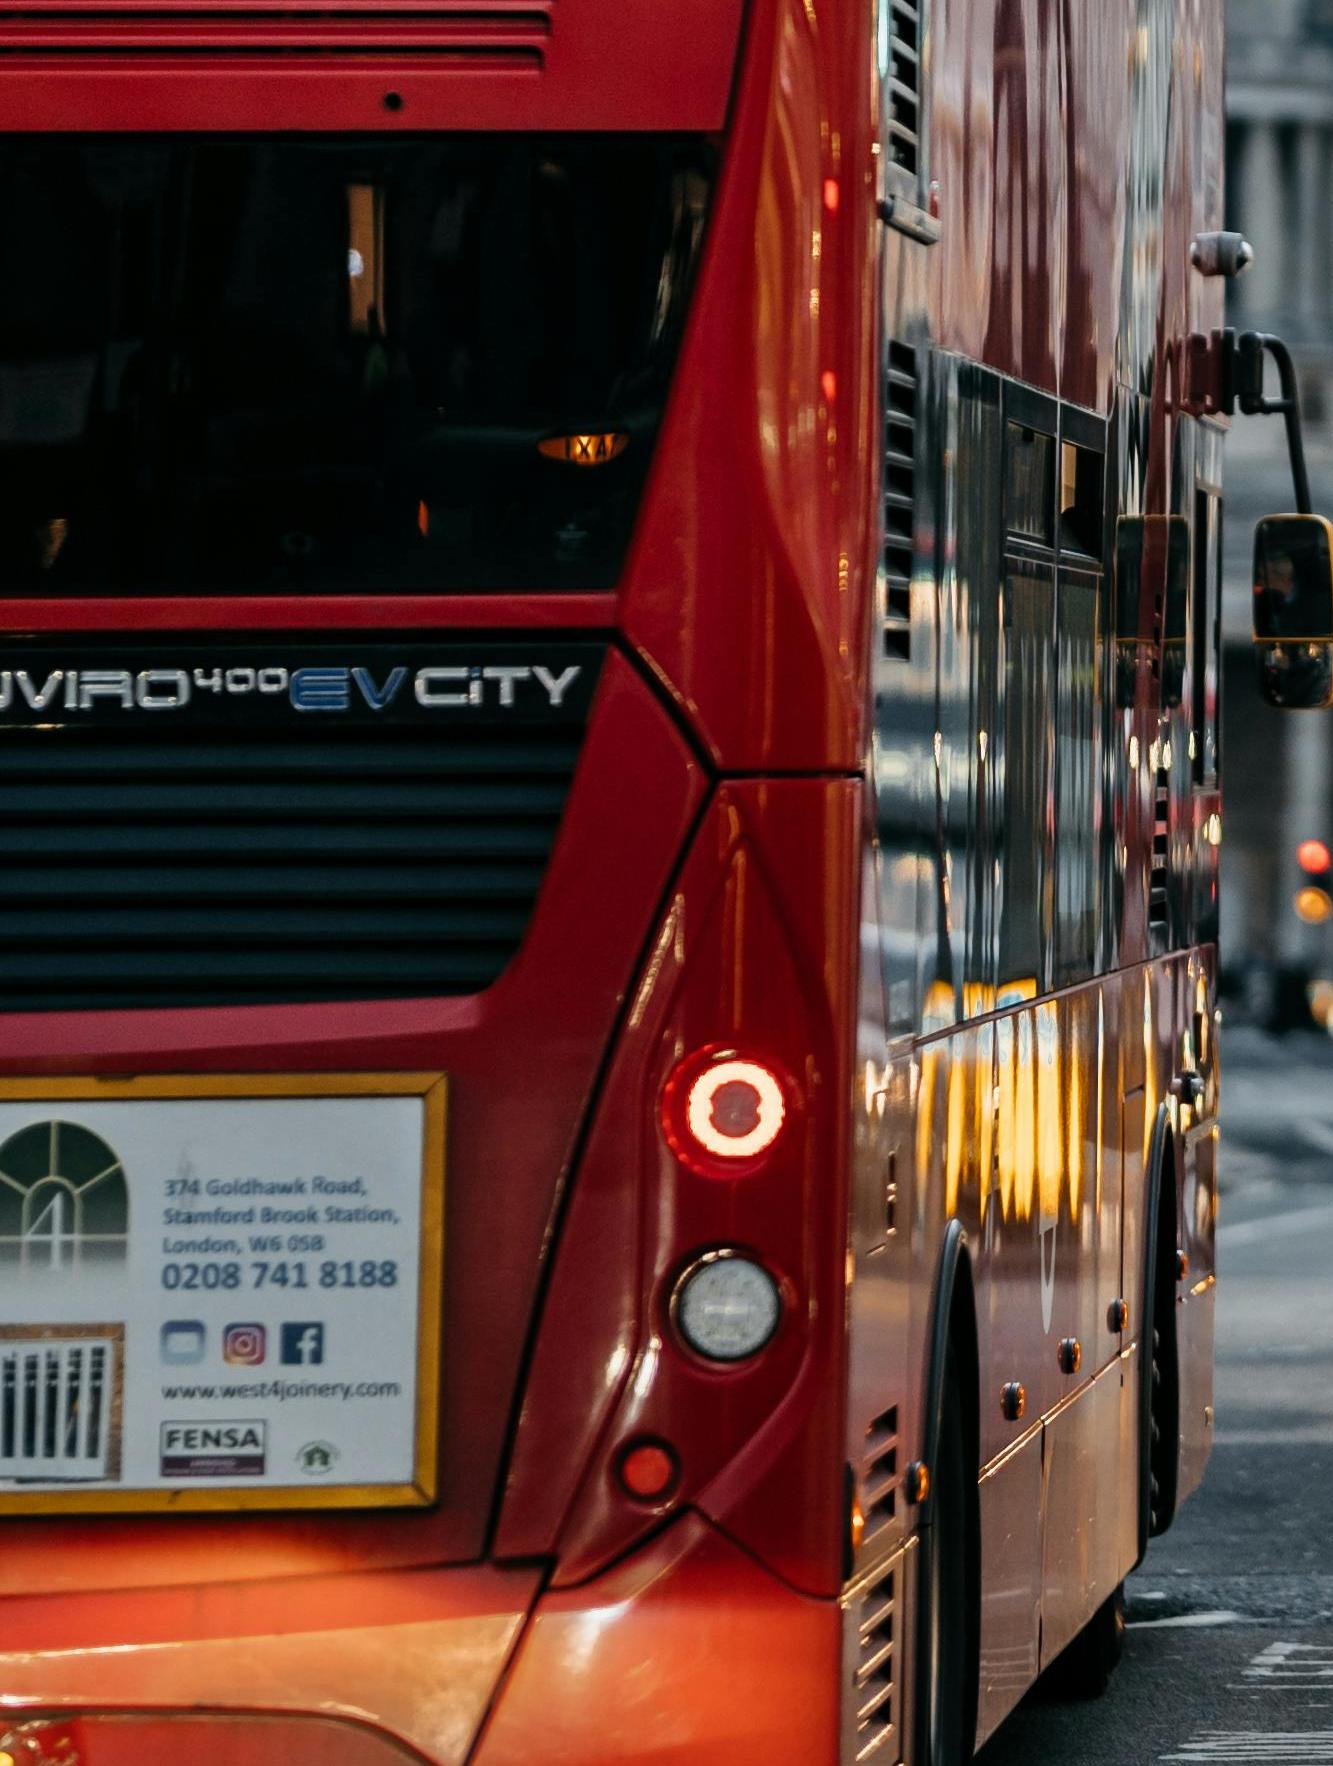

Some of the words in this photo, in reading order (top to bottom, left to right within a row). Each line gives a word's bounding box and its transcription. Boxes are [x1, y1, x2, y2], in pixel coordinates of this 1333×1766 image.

[164, 1179, 199, 1197] 374
[206, 1179, 305, 1197] Goldhawk
[312, 1176, 367, 1198] Road,
[163, 1207, 255, 1225] Stamford
[260, 1207, 319, 1224] Brook
[324, 1205, 399, 1224] Station,
[162, 1237, 243, 1254] London,
[248, 1237, 283, 1252] W6
[161, 1263, 241, 1290] 0208
[252, 1262, 308, 1289] 741
[318, 1260, 398, 1288] 8188
[161, 1379, 400, 1402] www.west4joinery.com
[165, 1428, 261, 1449] FENSA
